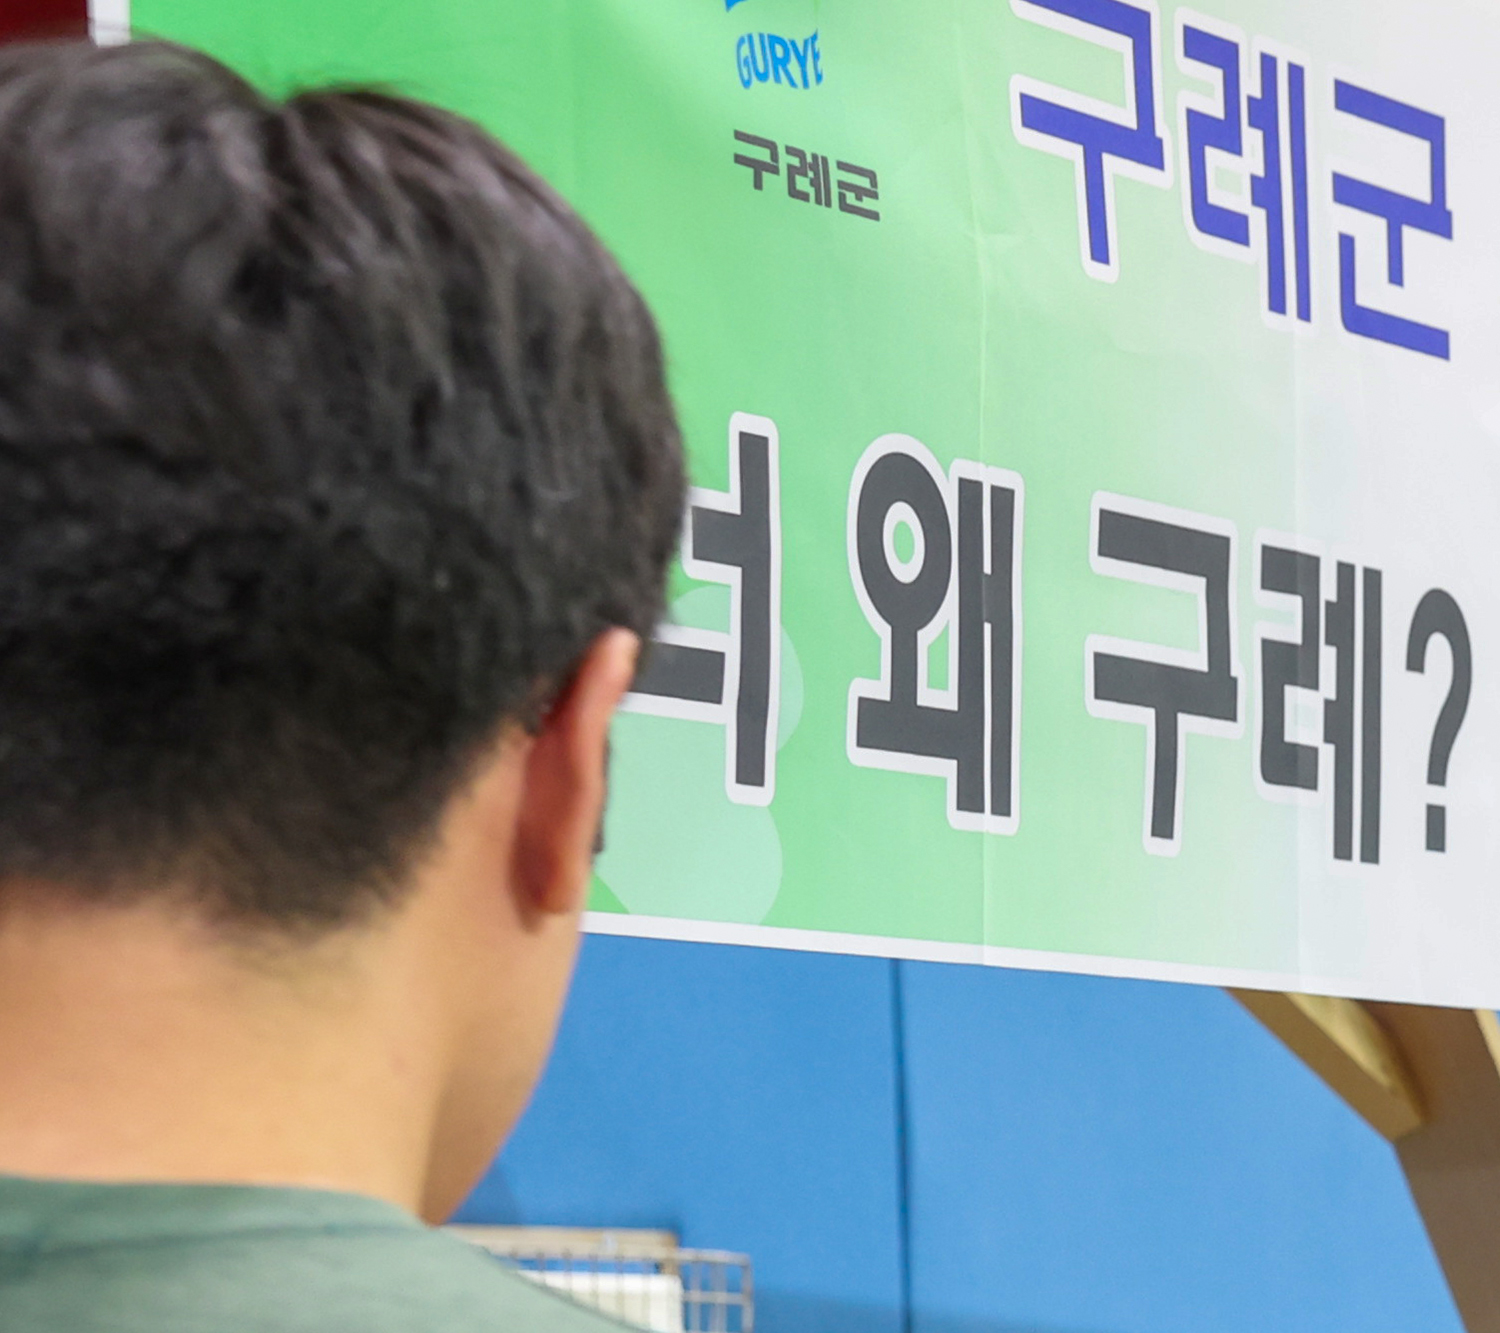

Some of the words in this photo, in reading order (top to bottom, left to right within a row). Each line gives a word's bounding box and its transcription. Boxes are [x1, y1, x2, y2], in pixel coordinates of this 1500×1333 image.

[736, 28, 823, 90] GURYE
[734, 129, 880, 222] 구례군
[1018, 0, 1453, 362] 구례군
[855, 450, 1016, 820] 왜
[1091, 505, 1473, 866] 구례?
